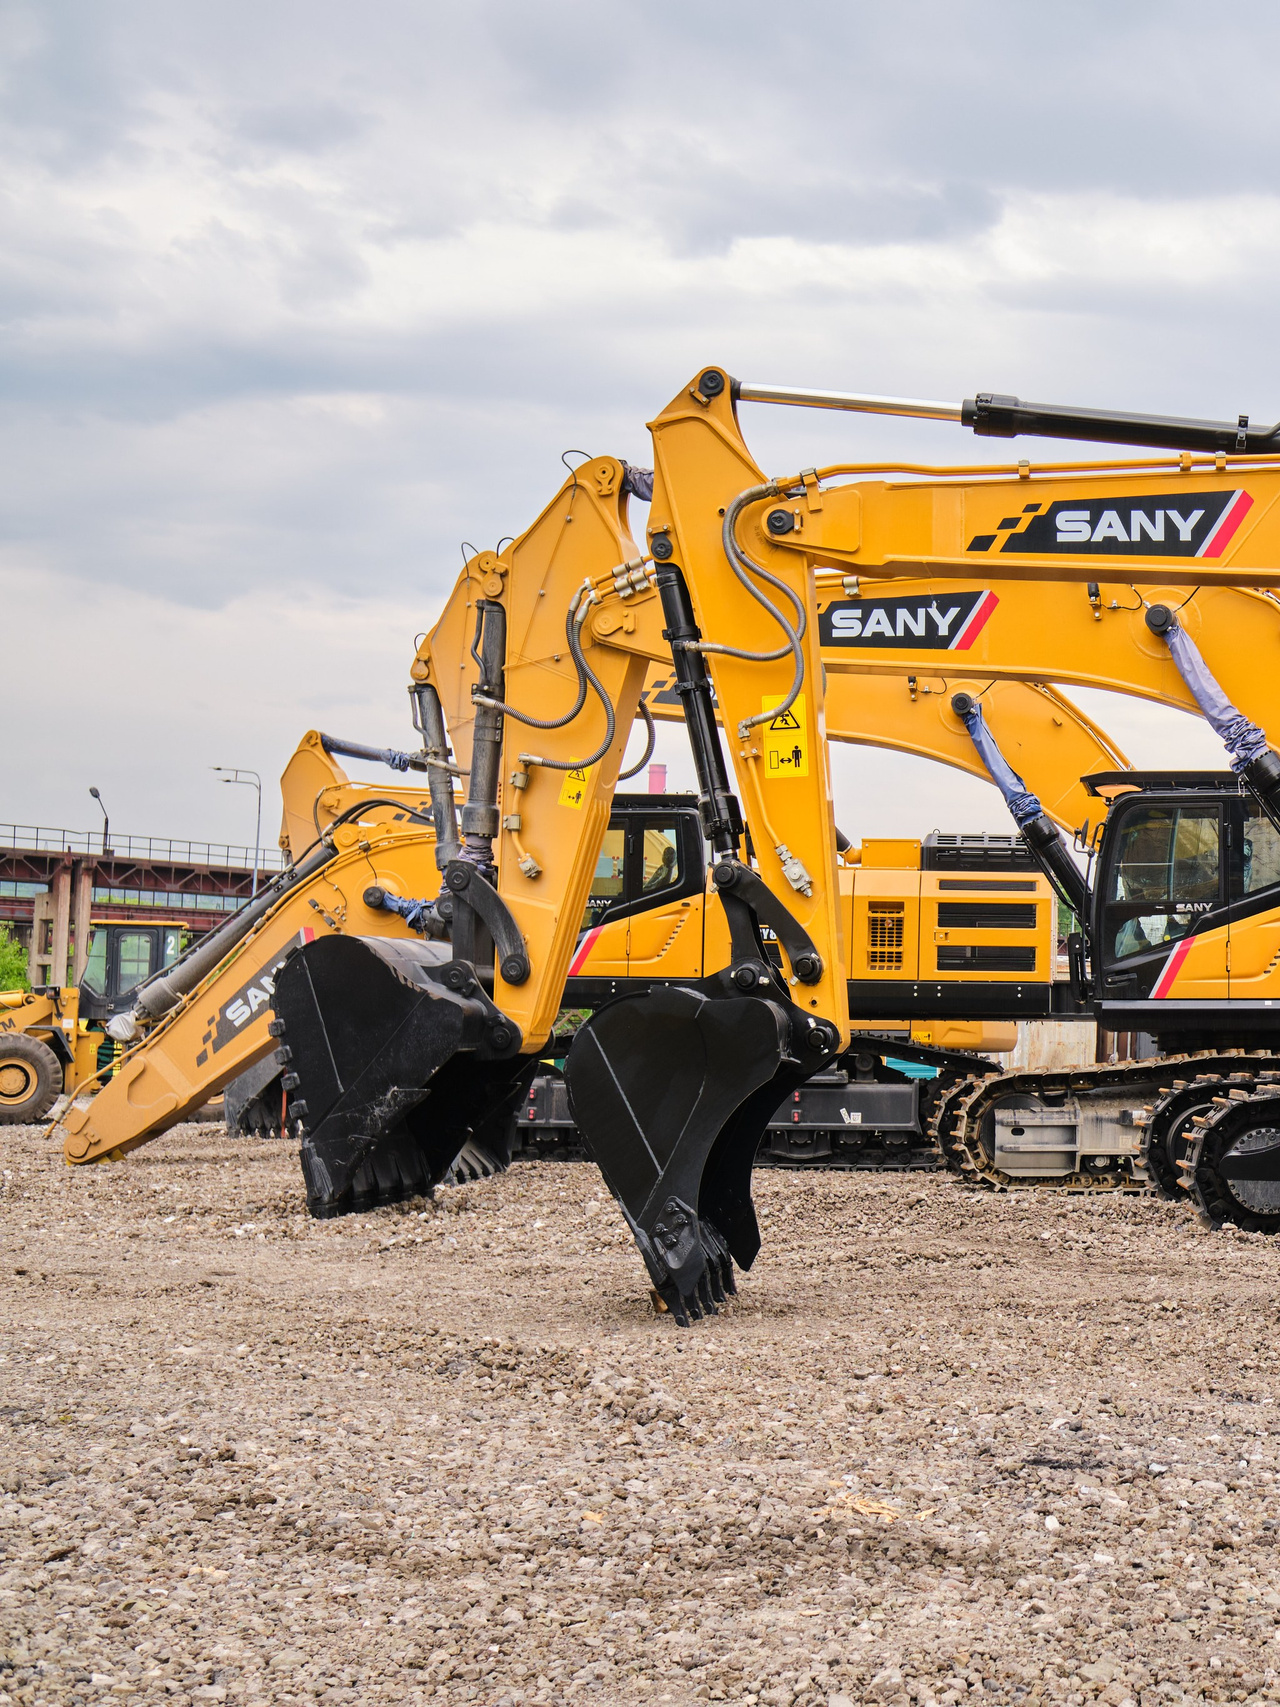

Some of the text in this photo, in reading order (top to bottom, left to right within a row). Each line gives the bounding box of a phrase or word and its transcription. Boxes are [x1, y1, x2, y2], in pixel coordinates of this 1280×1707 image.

[1055, 510, 1205, 542] SANY
[831, 607, 961, 637] SANY
[1175, 902, 1213, 912] SANY
[166, 935, 176, 955] 2
[225, 961, 286, 1028] SAN
